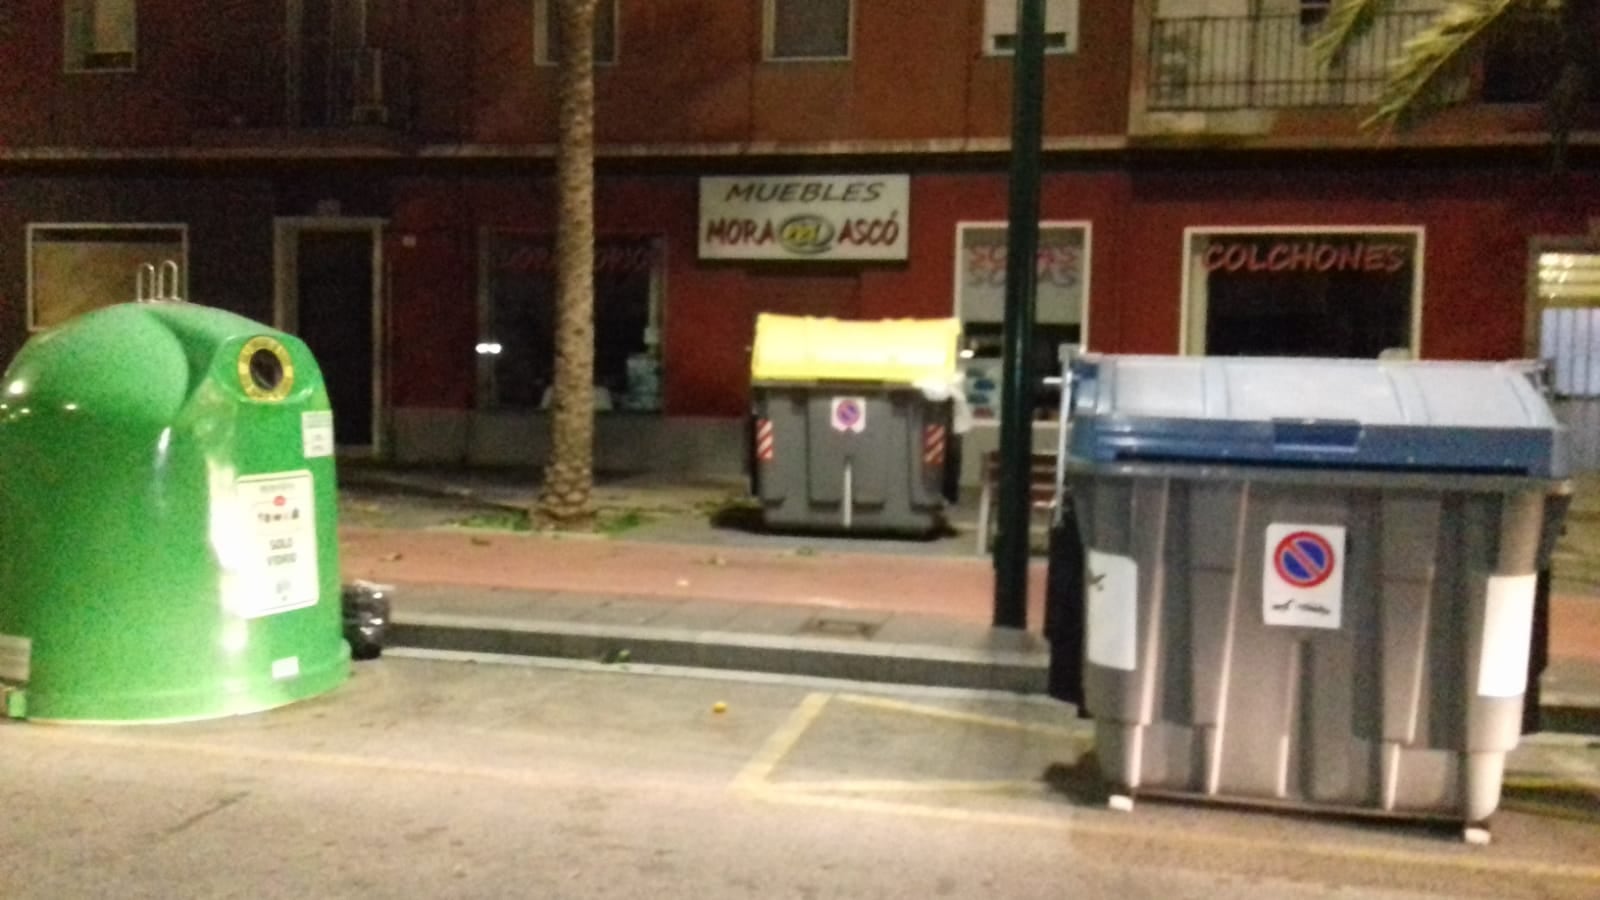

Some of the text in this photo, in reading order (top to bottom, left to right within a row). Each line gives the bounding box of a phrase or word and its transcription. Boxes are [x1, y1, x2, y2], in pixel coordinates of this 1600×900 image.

[725, 182, 886, 203] MUEBLES
[705, 217, 776, 246] MORA
[837, 209, 899, 246] ASCÓ
[968, 246, 1078, 272] SOAS
[1205, 242, 1406, 273] COLCHONES
